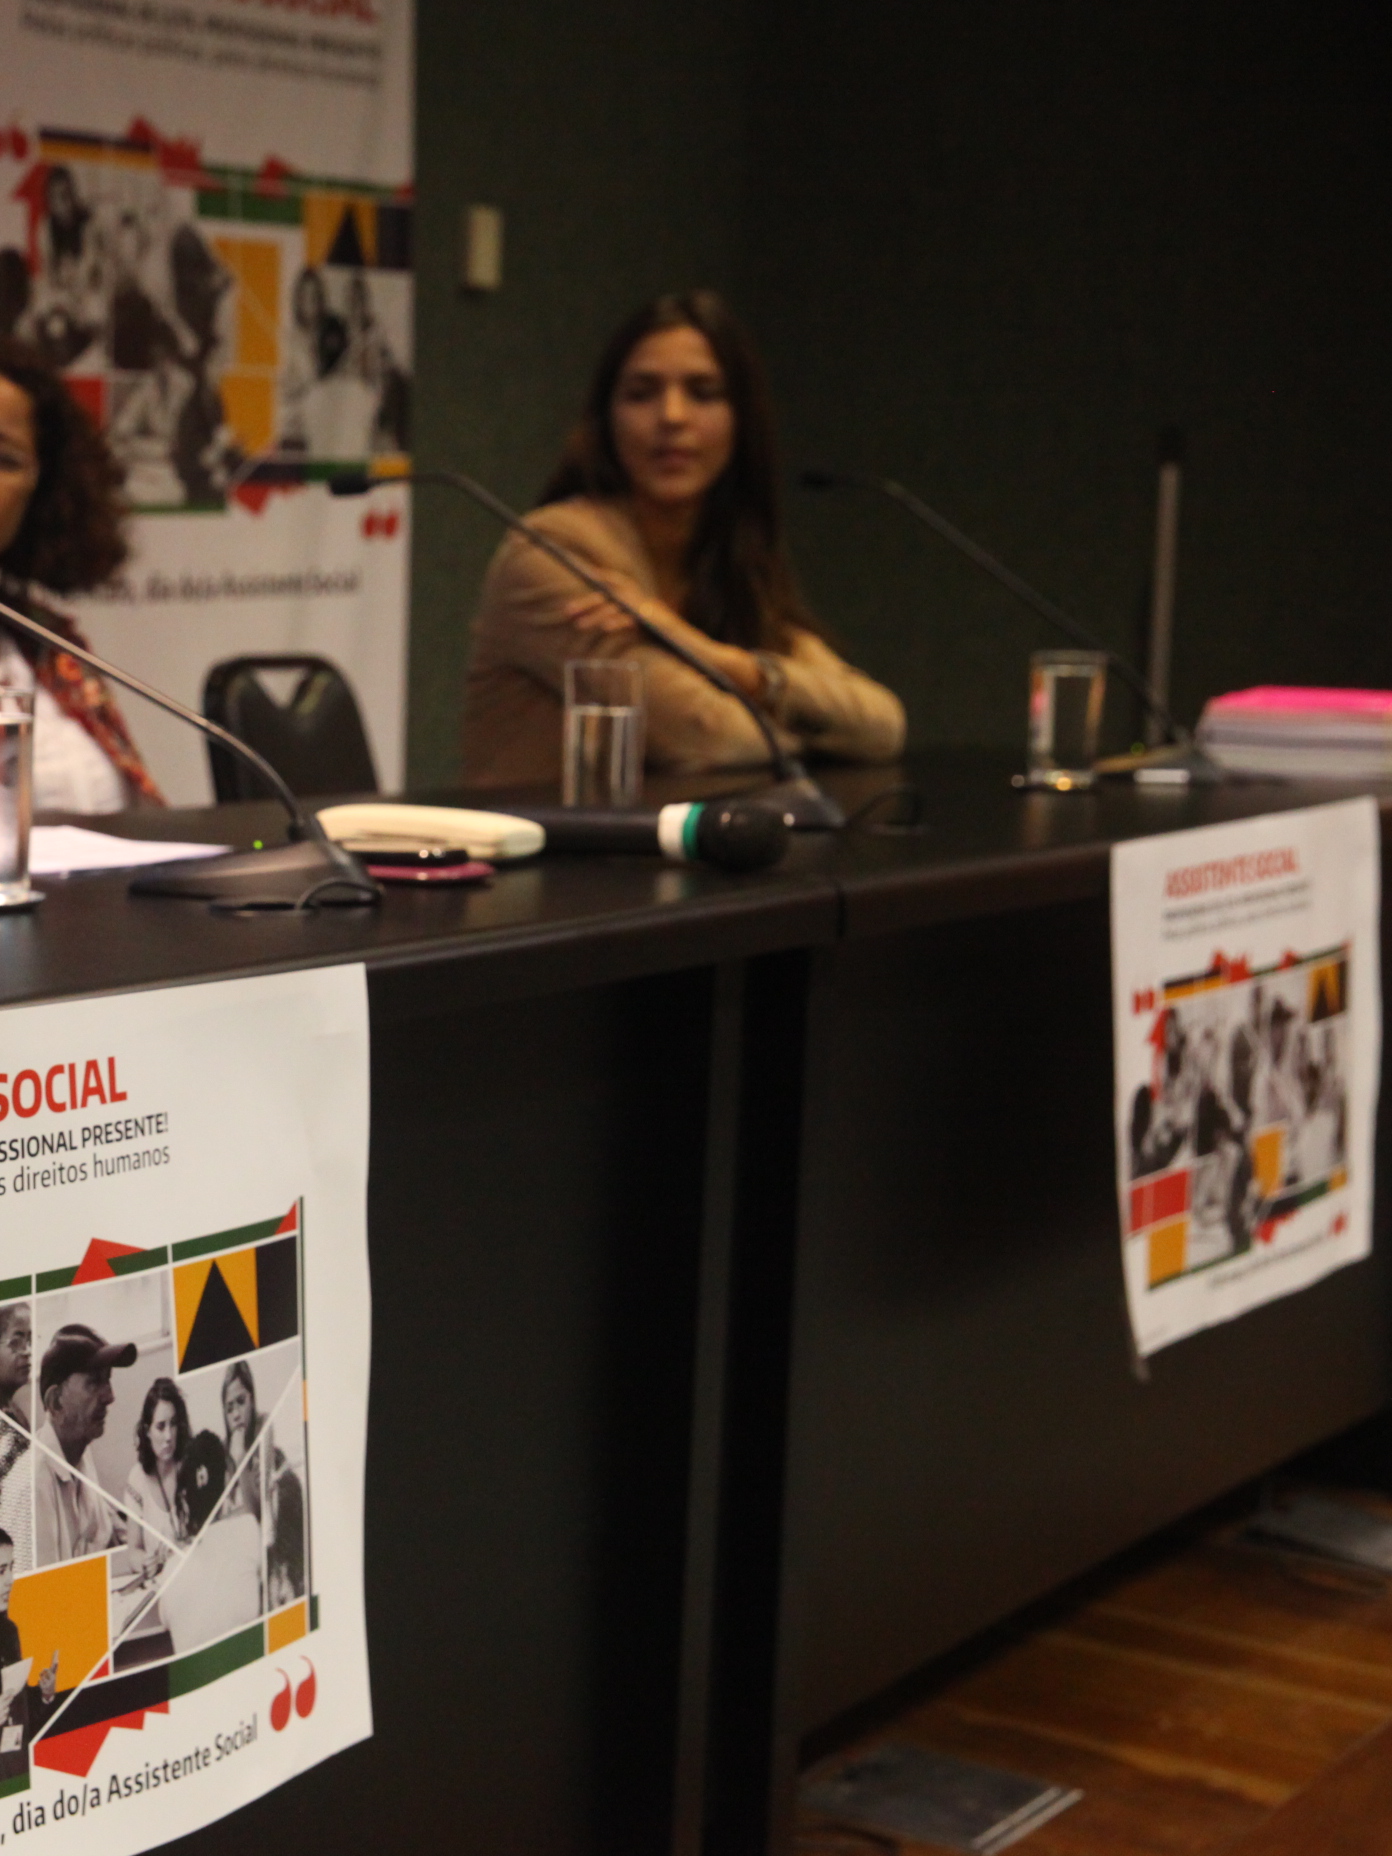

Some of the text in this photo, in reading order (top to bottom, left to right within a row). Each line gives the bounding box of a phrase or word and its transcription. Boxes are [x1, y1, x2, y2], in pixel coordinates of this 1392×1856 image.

[81, 1112, 169, 1149] PRESENTE!
[13, 1160, 88, 1194] direitos
[93, 1146, 171, 1178] humanos
[12, 1800, 46, 1835] dia
[52, 1784, 102, 1822] do/a
[107, 1748, 211, 1803] Assistente
[214, 1712, 258, 1762] Social
